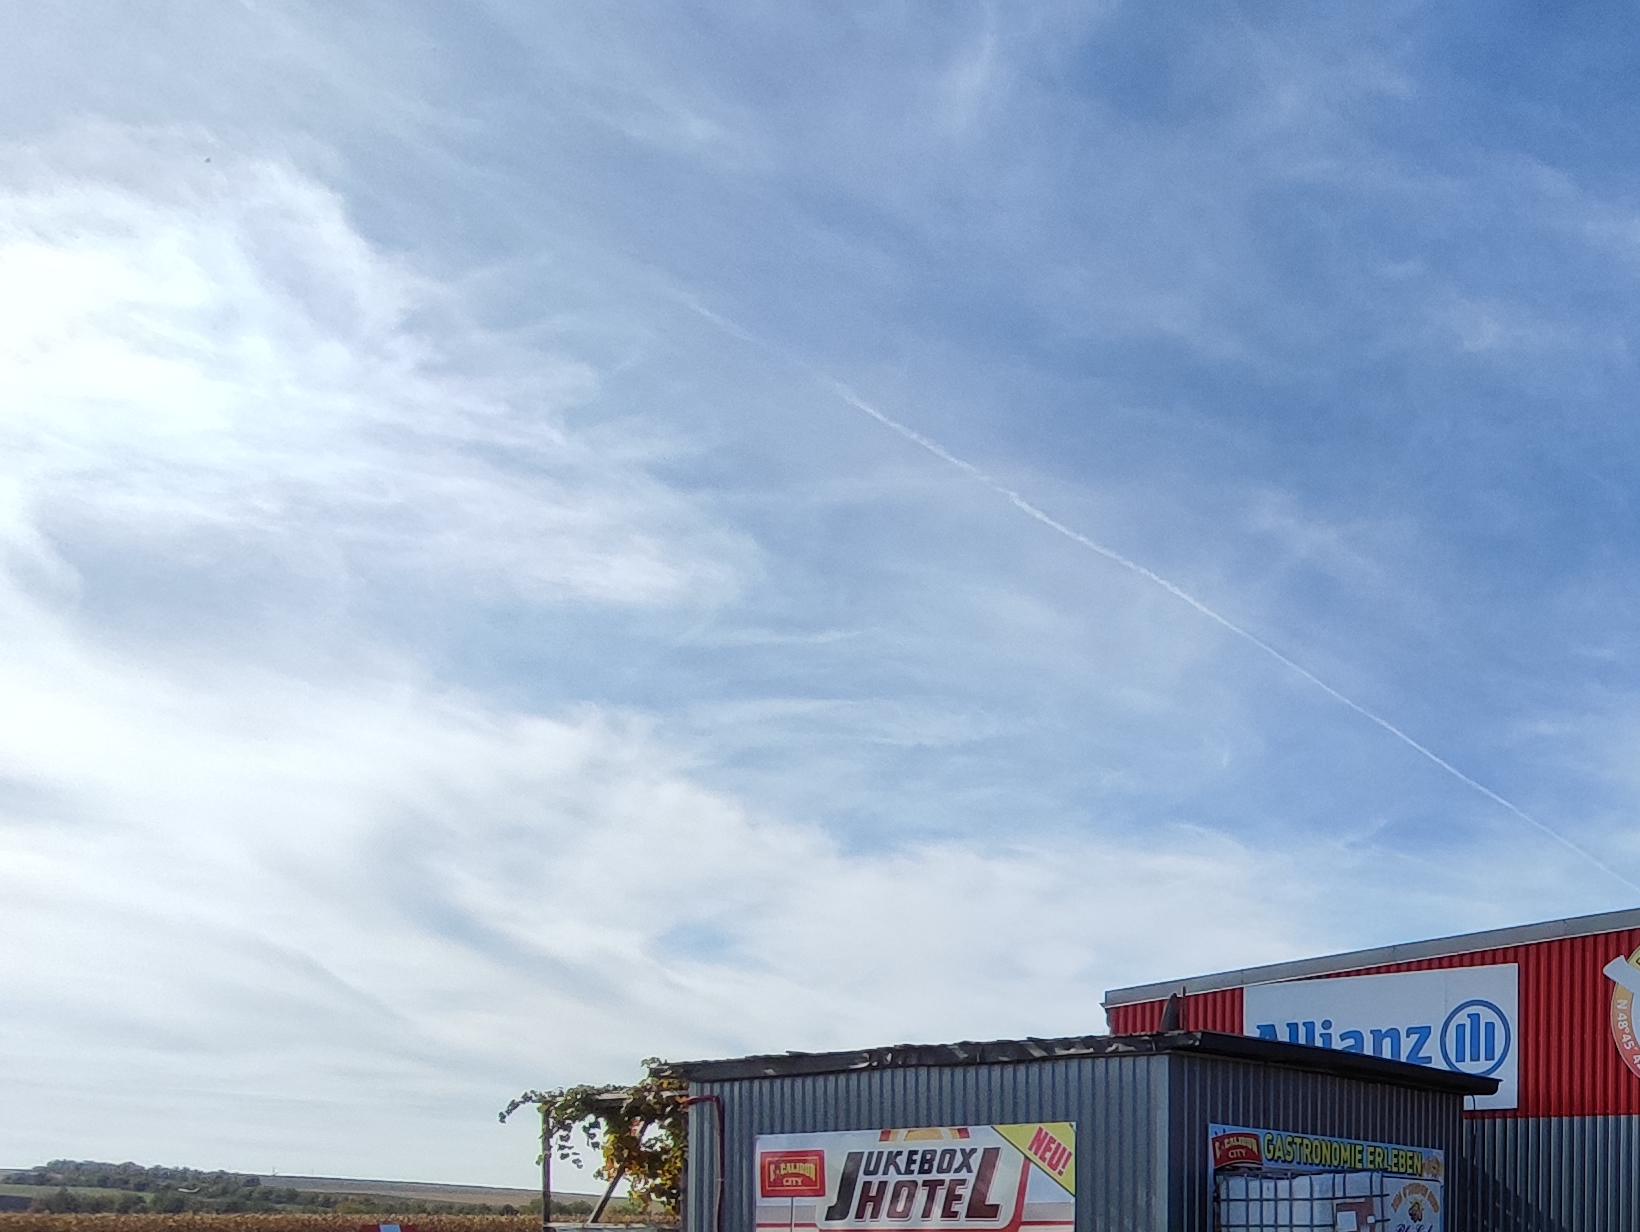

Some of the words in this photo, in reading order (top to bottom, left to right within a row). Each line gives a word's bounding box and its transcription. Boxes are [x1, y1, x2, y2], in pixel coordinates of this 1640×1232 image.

[1617, 999, 1628, 1010] N
[1027, 1125, 1073, 1177] NEU!
[1228, 1148, 1247, 1159] CITY
[1263, 1132, 1363, 1169] GASTRONOMIE
[1367, 1146, 1423, 1176] ERLEBEN
[782, 1176, 804, 1186] CITY
[825, 1147, 978, 1222] JUKEBOX
[854, 1147, 1002, 1222] HOTEL
